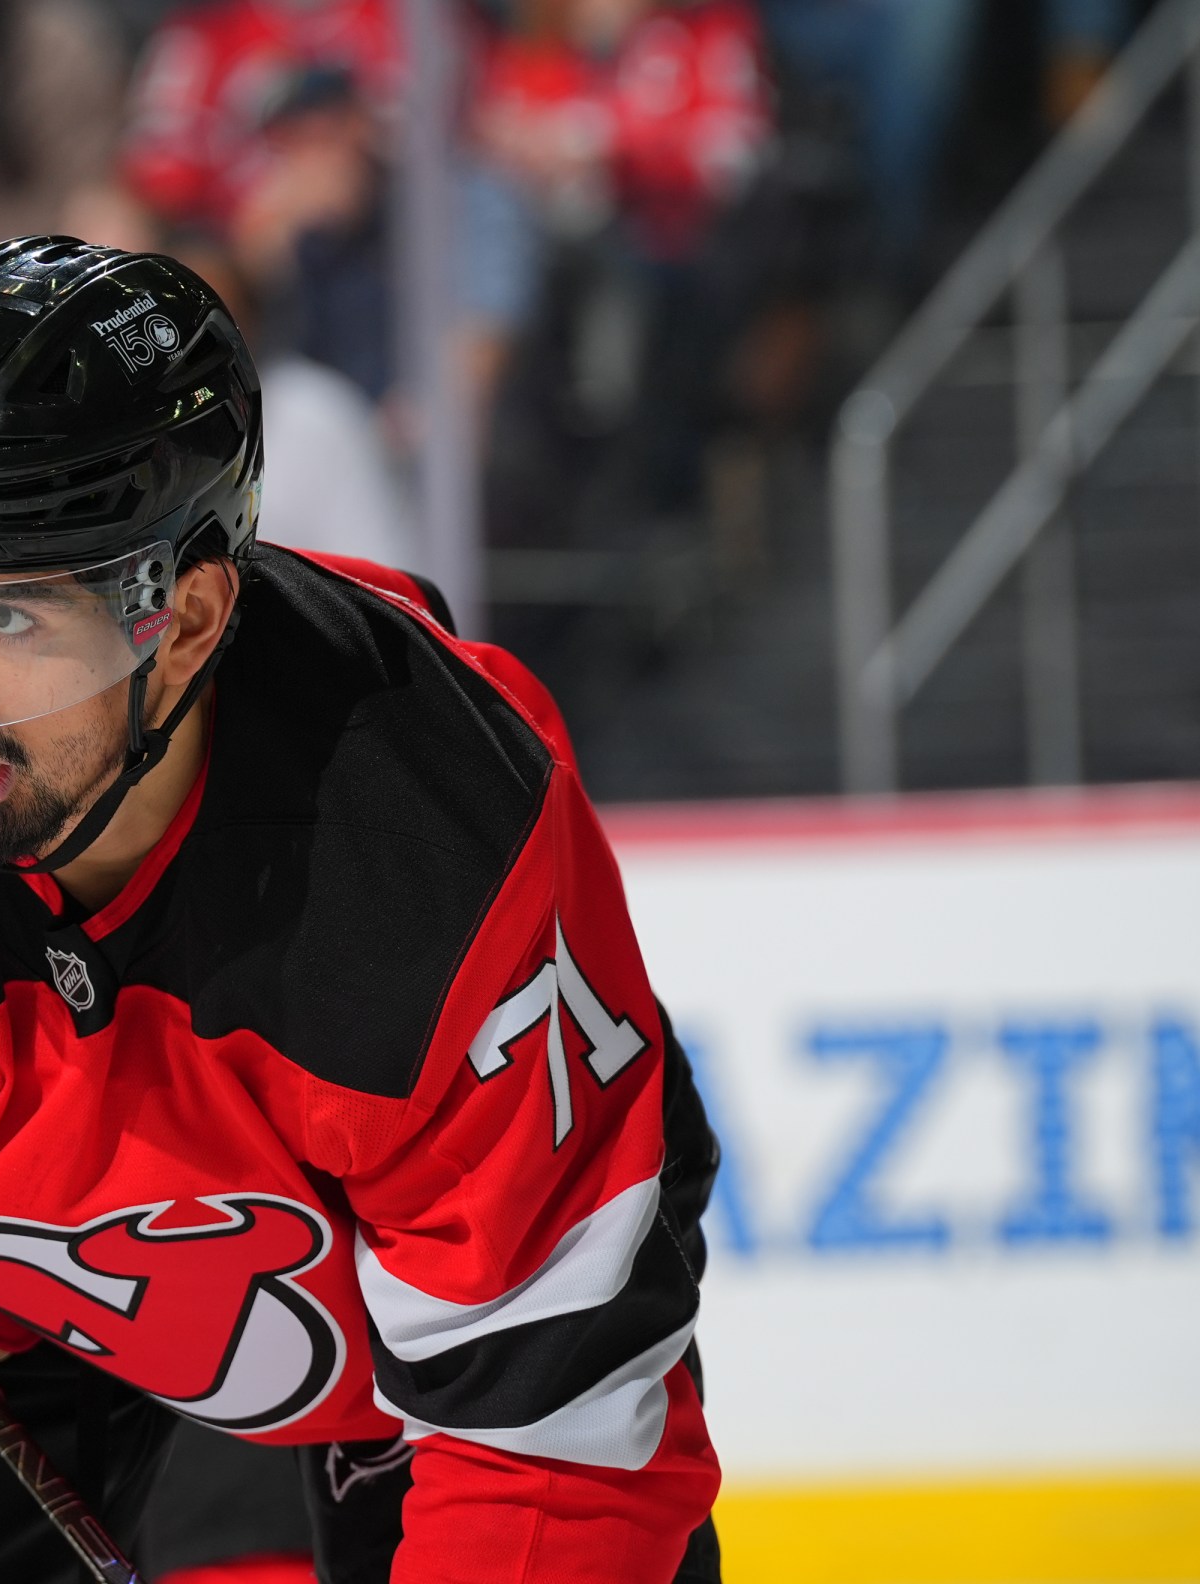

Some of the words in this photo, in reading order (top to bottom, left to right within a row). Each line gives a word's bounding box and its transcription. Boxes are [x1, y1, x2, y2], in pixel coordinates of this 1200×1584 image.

[90, 293, 158, 337] Prudential
[105, 313, 180, 374] 150
[62, 966, 82, 993] NHL
[465, 908, 652, 1154] 71
